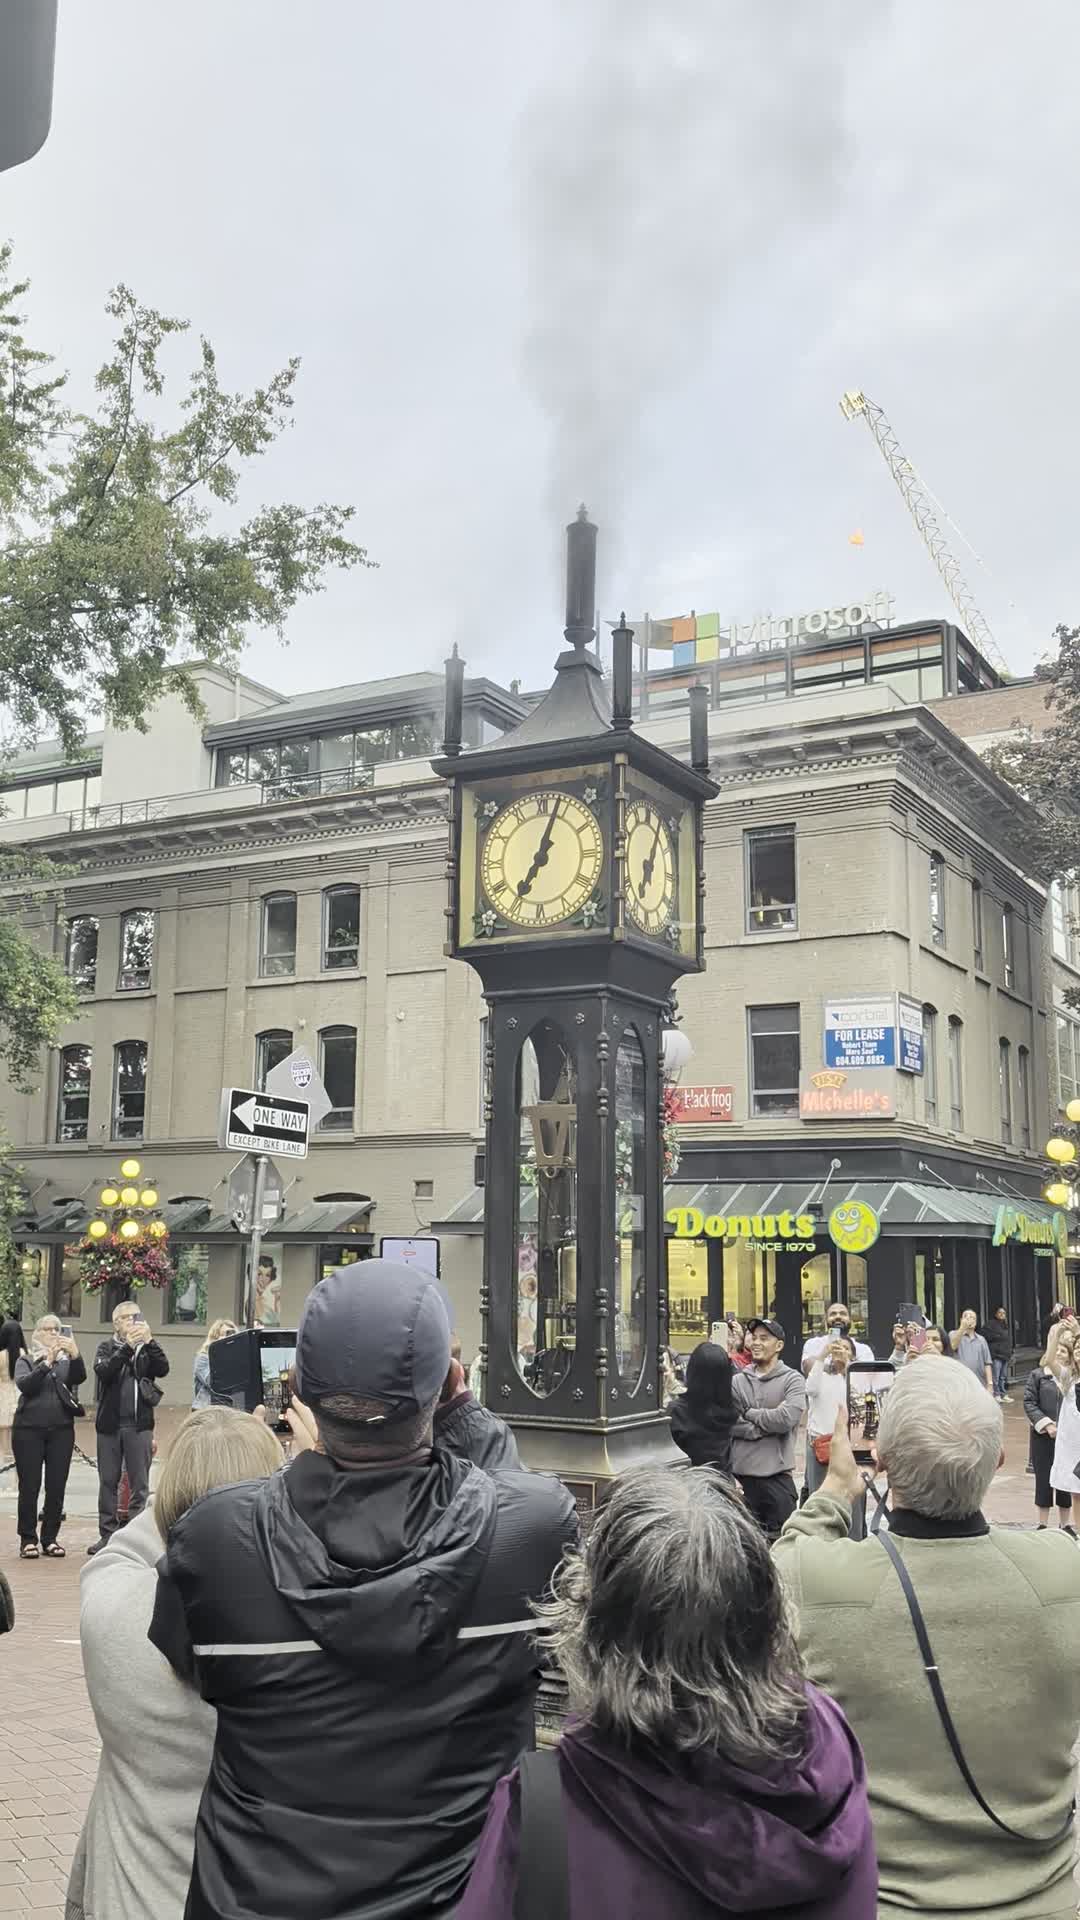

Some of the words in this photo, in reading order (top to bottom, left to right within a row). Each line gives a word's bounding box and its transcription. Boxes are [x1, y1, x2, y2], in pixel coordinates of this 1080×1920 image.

[730, 591, 896, 646] Microsoft
[835, 1031, 853, 1041] FOR
[855, 1029, 885, 1040] LEASE
[711, 1088, 732, 1112] frog
[802, 1089, 889, 1111] Michelle's
[253, 1107, 276, 1126] ONE
[281, 1111, 304, 1130] WAY
[233, 1134, 261, 1147] EXCEPT
[263, 1139, 280, 1150] BIKE
[282, 1142, 301, 1153] LANE
[666, 1207, 817, 1239] Donuts
[744, 1242, 783, 1252] SINCE
